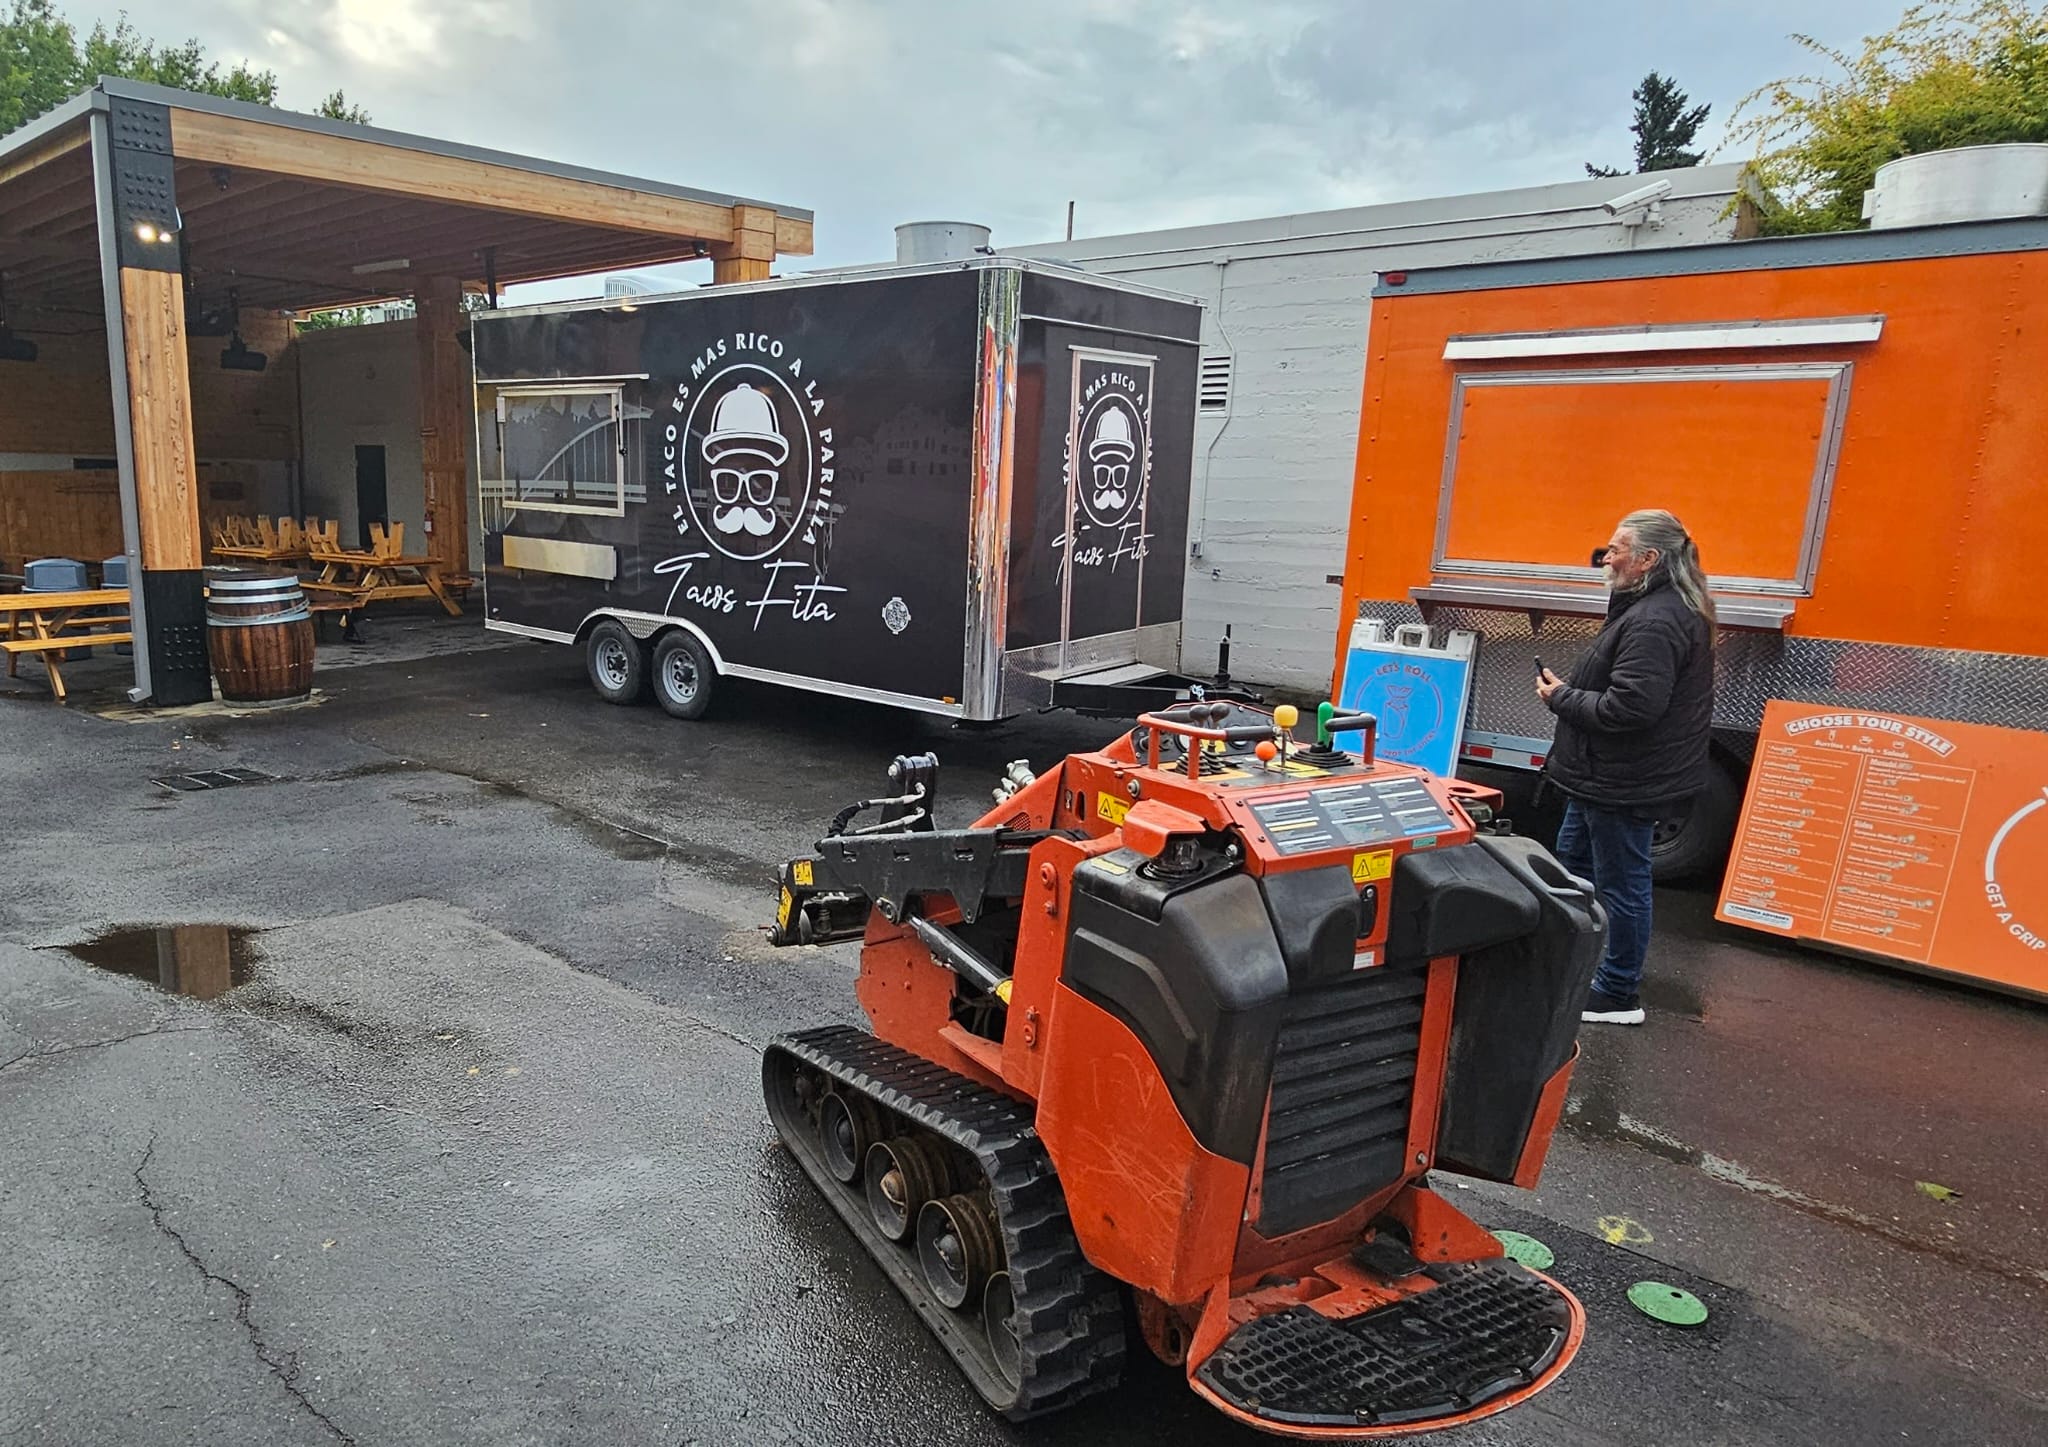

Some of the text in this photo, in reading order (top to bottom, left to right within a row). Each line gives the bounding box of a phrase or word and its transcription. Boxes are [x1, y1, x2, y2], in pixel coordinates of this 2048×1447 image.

[1085, 373, 1107, 401] MAS
[1111, 372, 1136, 392] RICO
[664, 332, 835, 546] EL TACO ES MAS RICO A LA PARILLA
[653, 552, 738, 617] Tacos
[745, 558, 848, 632] Fita
[1376, 661, 1432, 683] LET'S ROLL
[1788, 715, 1951, 754] CHOOSE YOUR STYLE
[1985, 883, 2047, 950] GET A GRIP
